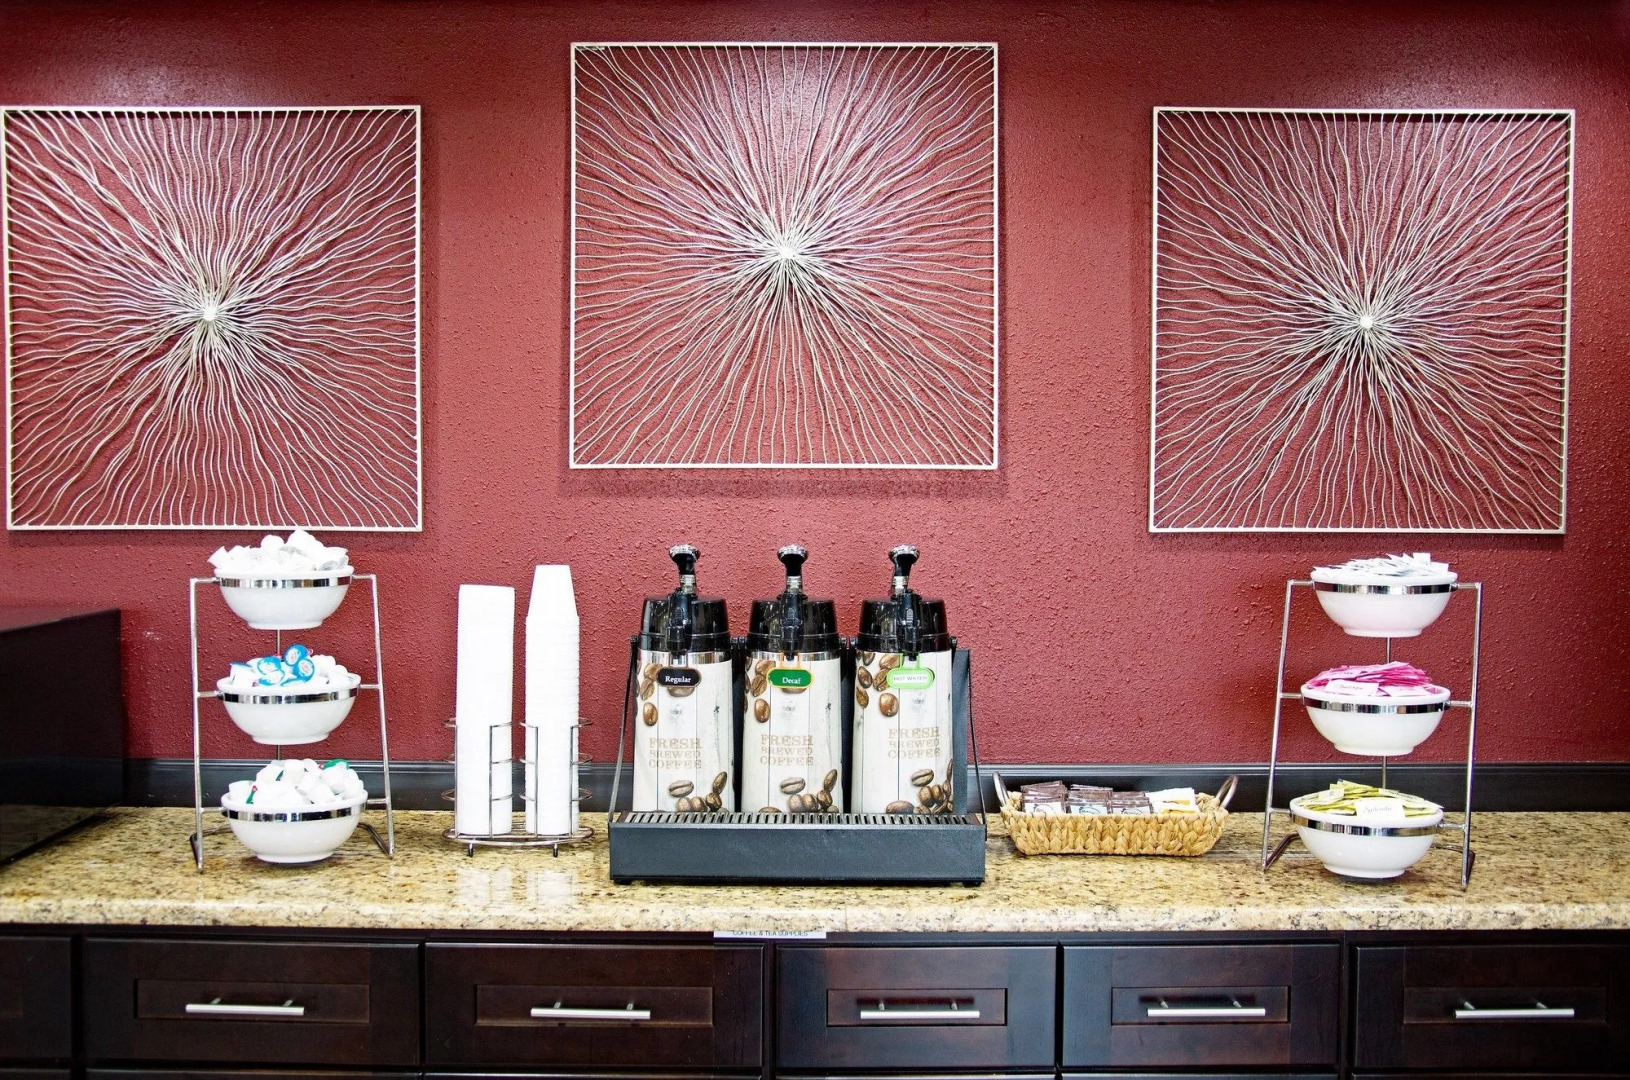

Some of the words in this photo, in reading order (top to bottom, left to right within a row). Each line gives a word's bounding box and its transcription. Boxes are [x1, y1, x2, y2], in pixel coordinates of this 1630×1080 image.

[665, 675, 692, 685] Regular
[888, 726, 940, 738] FRESH
[649, 737, 702, 749] FRESH
[761, 734, 814, 746] FRESH
[889, 738, 939, 748] BREWED
[649, 749, 701, 759] BREWED
[761, 746, 813, 756] BREWED
[888, 747, 940, 759] COFFEE
[649, 759, 702, 769] COFFEE
[760, 756, 814, 766] COFFEE
